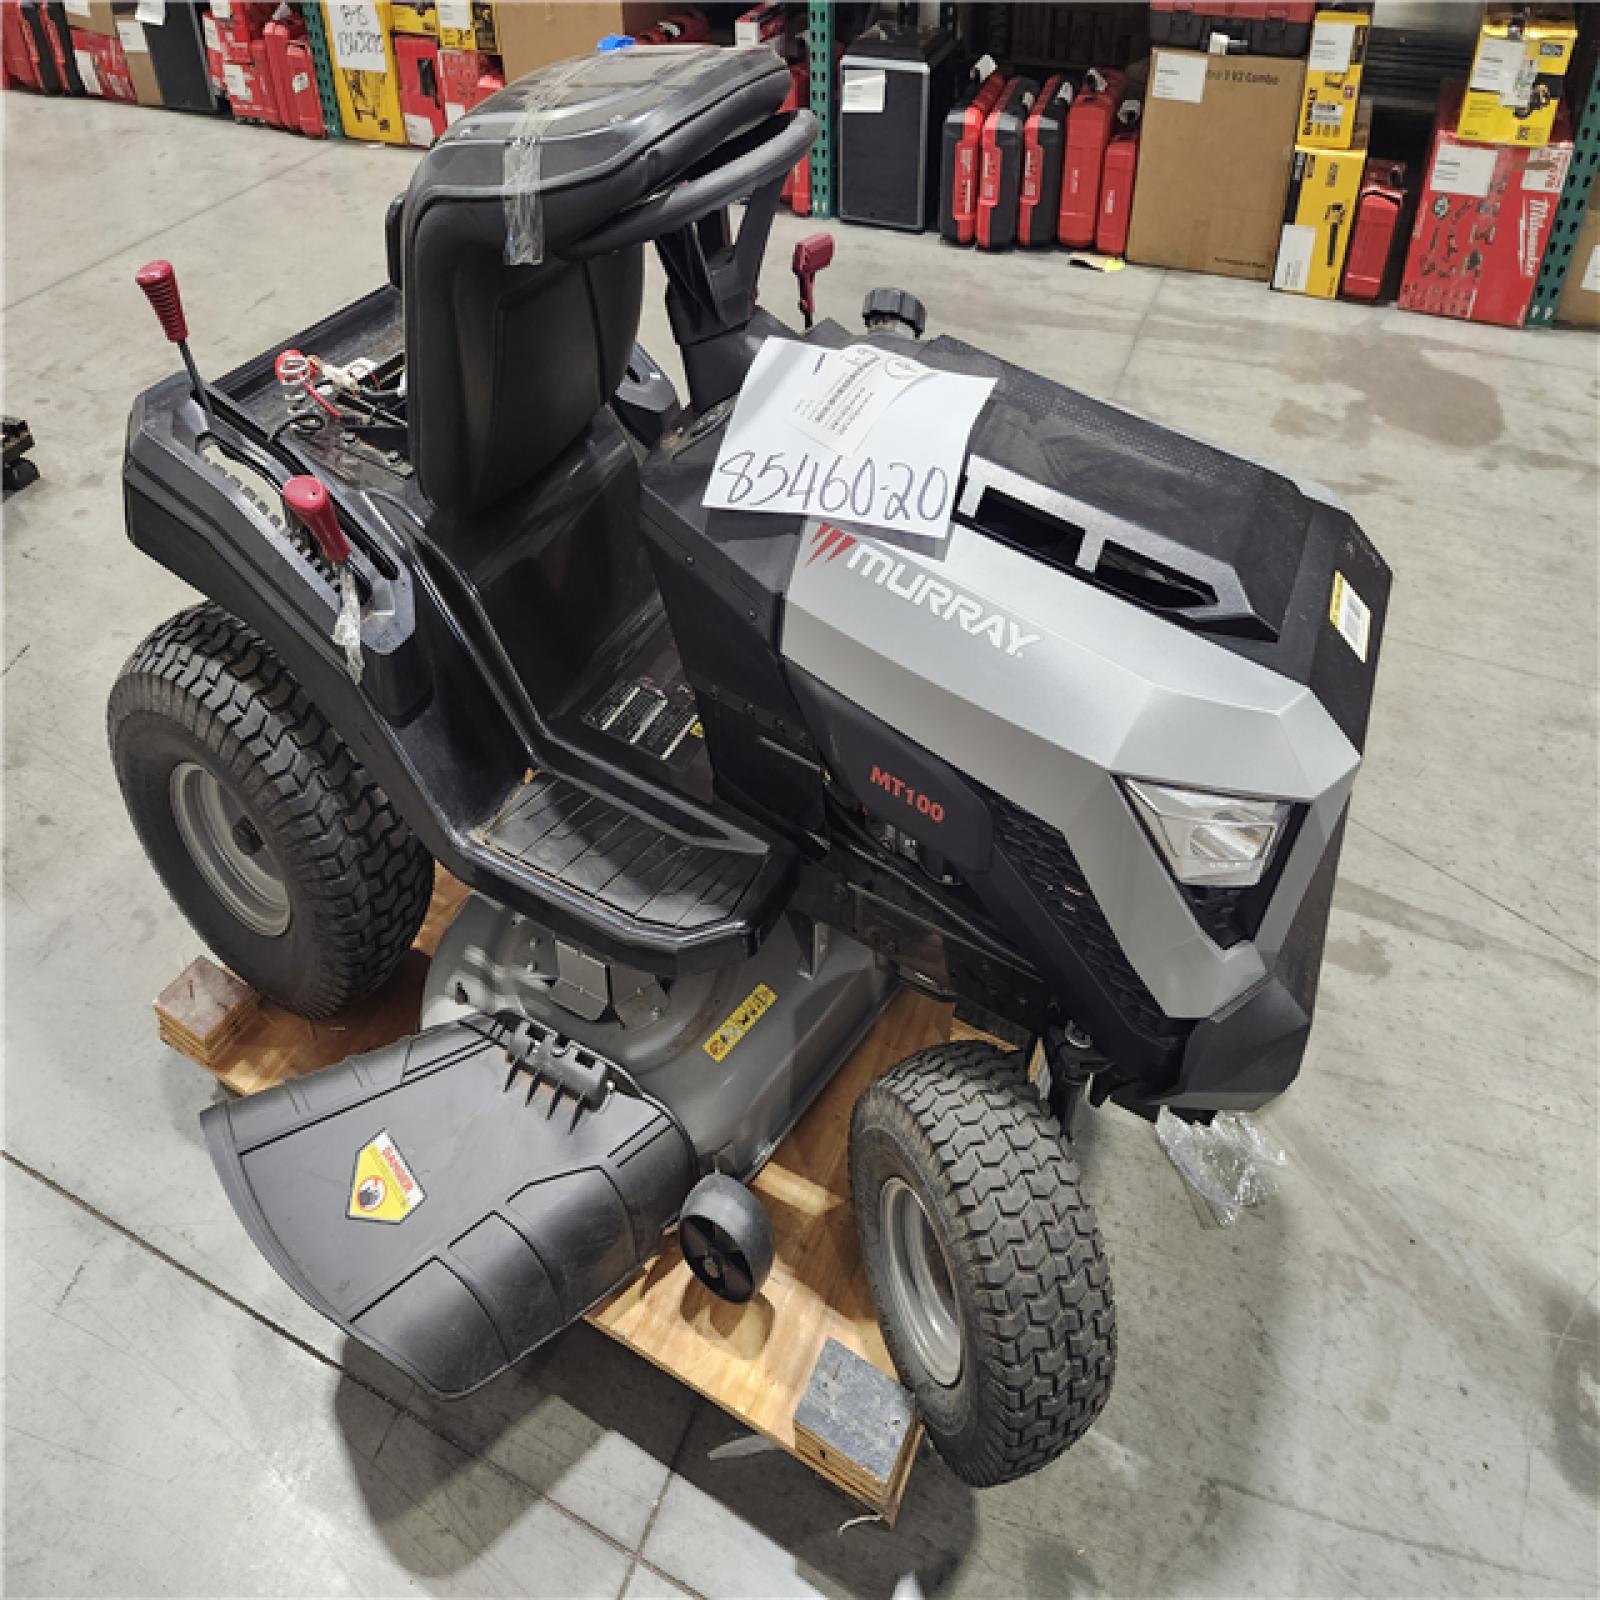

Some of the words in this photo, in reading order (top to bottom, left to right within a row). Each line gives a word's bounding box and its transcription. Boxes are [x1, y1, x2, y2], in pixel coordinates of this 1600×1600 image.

[718, 450, 949, 521] 85460-20
[846, 542, 1041, 657] MURRAY
[869, 765, 945, 823] MT100
